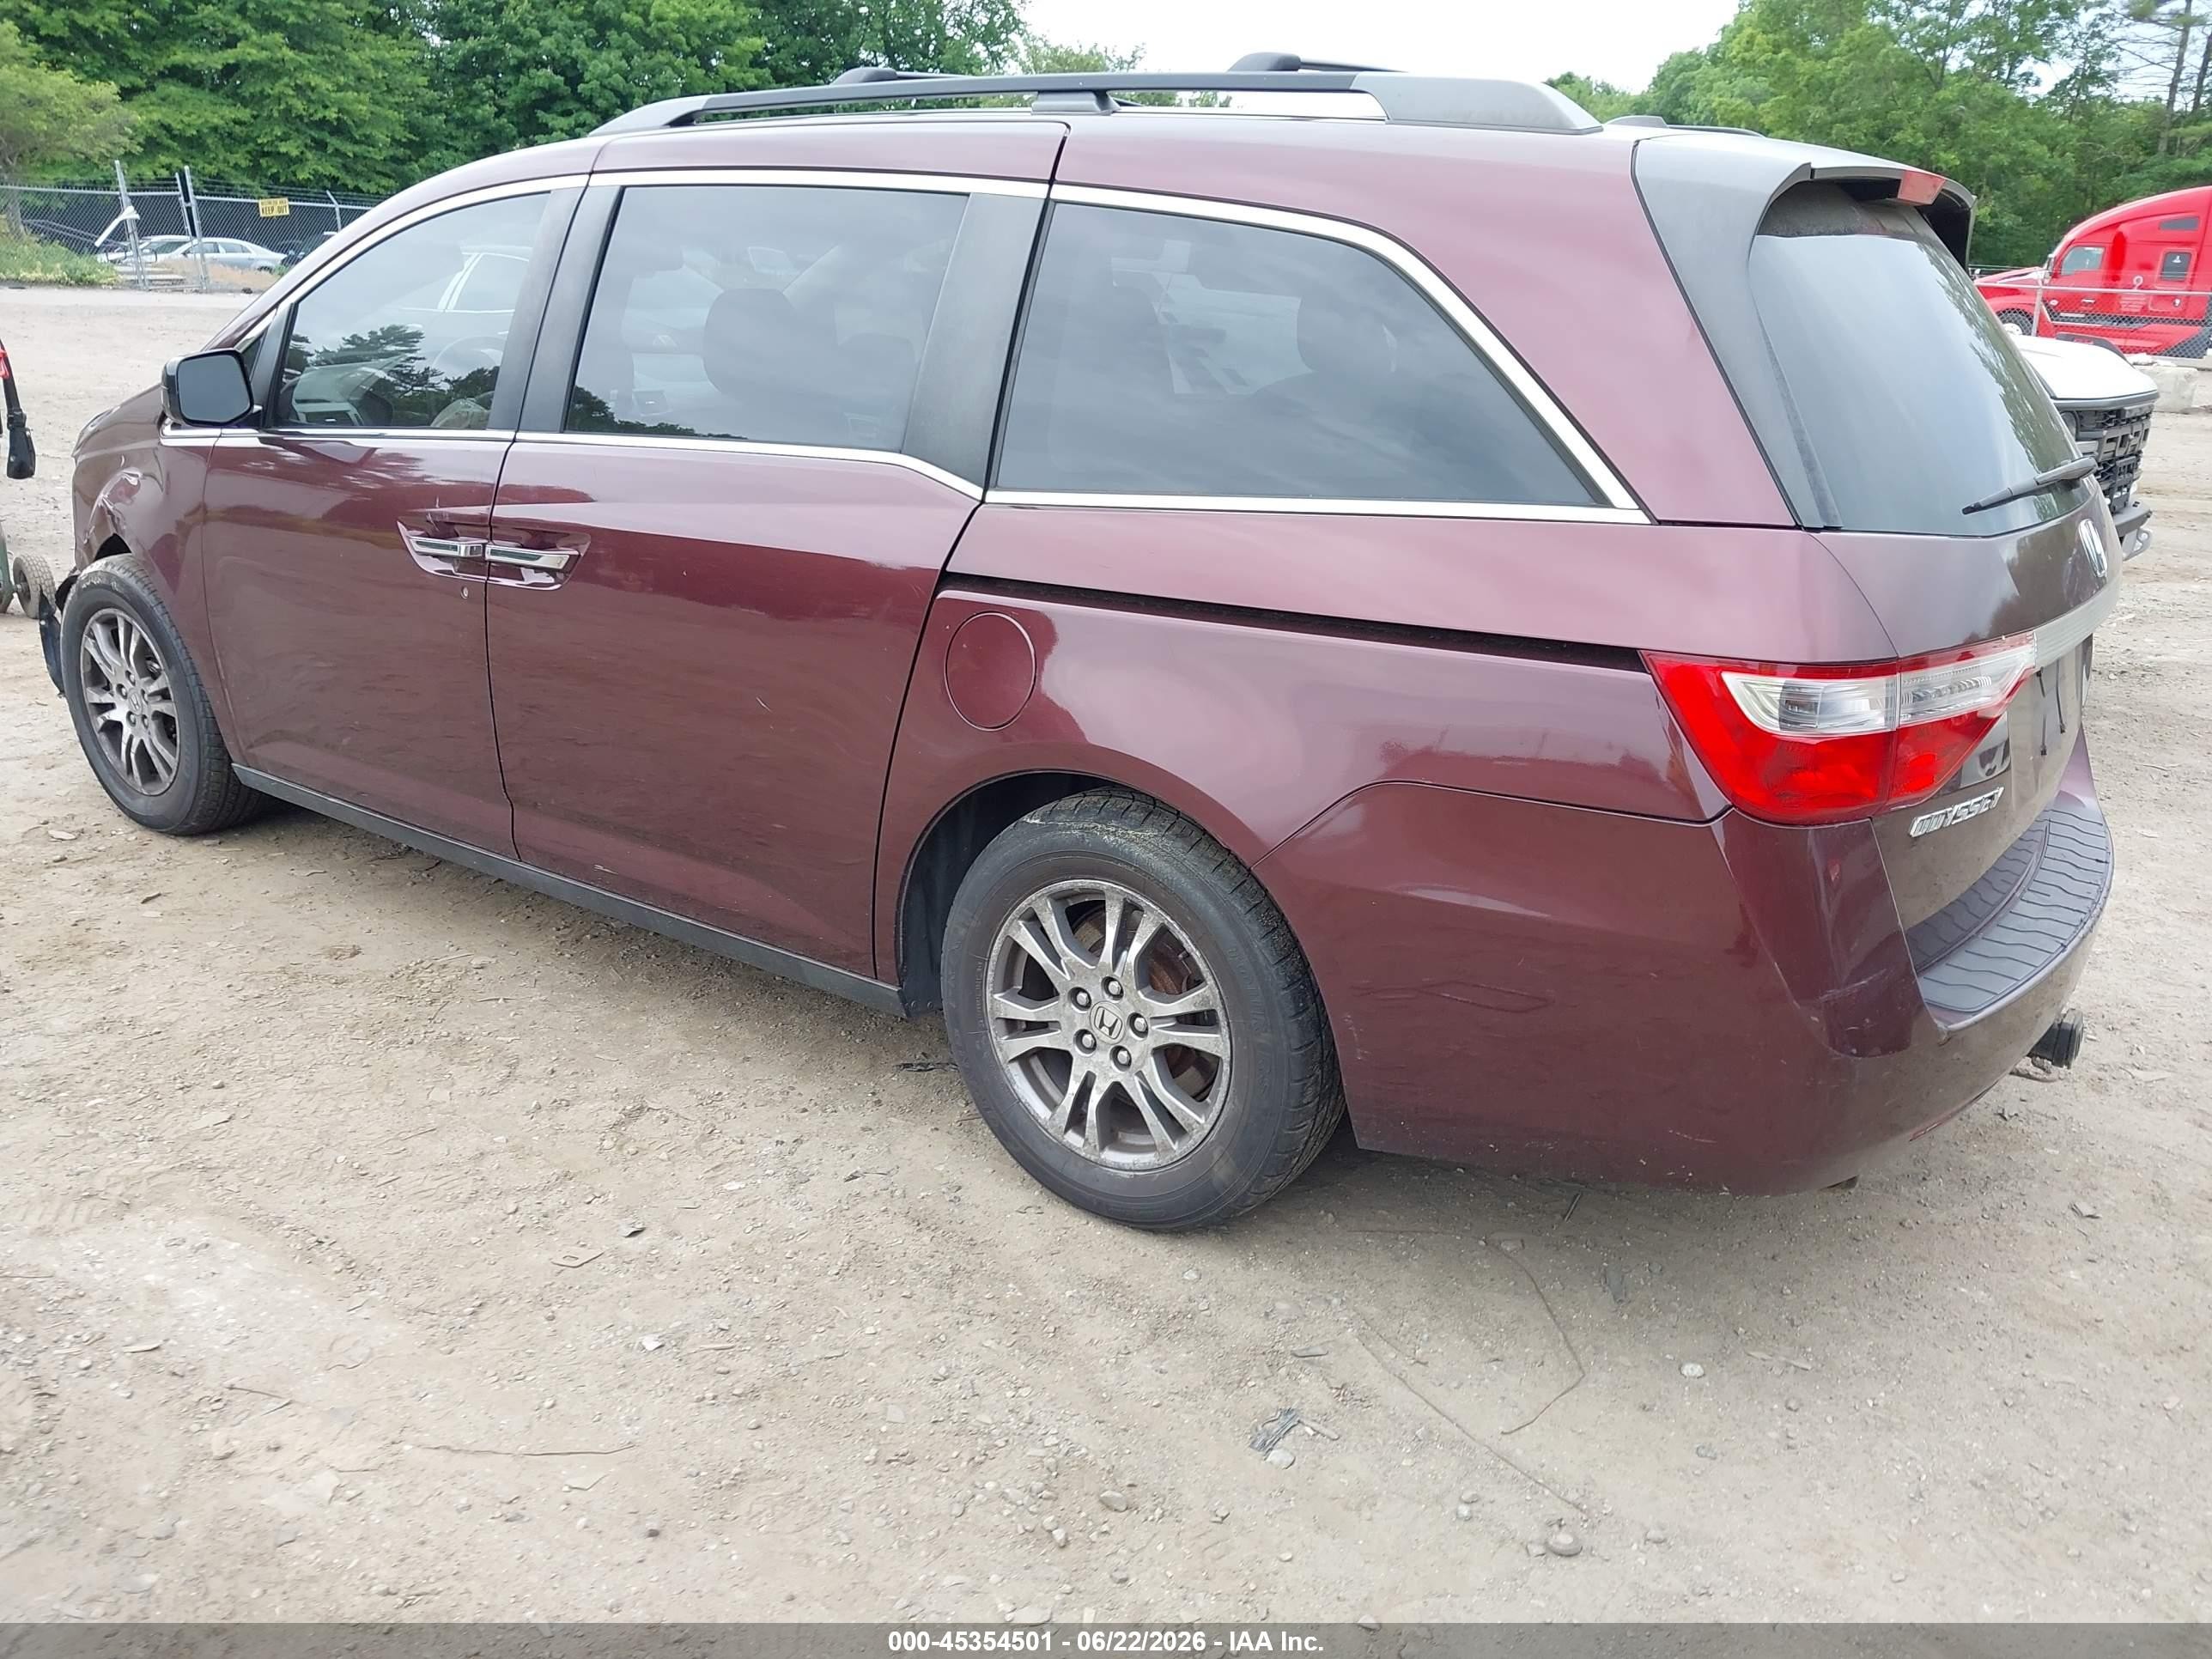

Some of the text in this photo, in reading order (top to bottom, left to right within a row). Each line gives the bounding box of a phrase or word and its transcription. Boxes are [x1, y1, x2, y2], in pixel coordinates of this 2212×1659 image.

[262, 204, 288, 215] KEEP OUT
[1909, 787, 2005, 838] ODYSSEY
